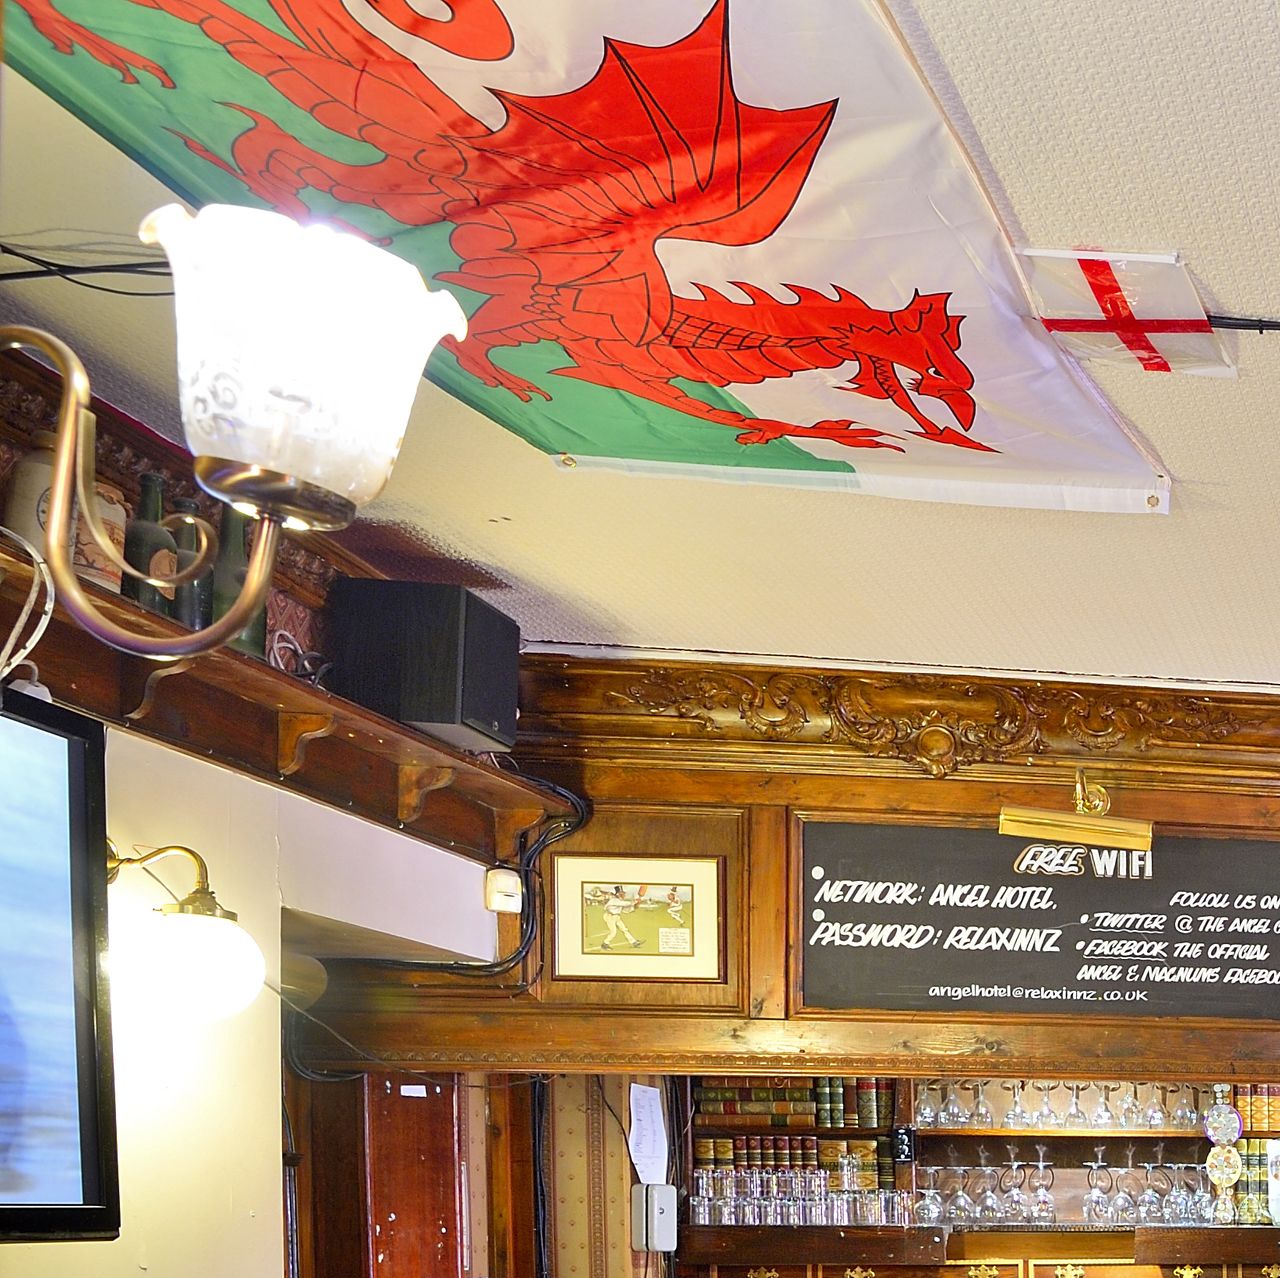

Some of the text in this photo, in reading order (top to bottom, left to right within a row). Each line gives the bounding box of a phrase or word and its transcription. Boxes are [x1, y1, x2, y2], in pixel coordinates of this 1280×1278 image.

[1015, 845, 1153, 879] FREE WIFI
[814, 880, 925, 905] NETWORK:
[929, 883, 990, 908] ANGEL
[1169, 891, 1231, 908] FOLLOW
[1233, 894, 1256, 909] US
[1093, 912, 1167, 930] TWITTER
[1174, 914, 1193, 933] @
[1197, 915, 1227, 933] THE
[1228, 917, 1271, 934] ANGEL
[943, 926, 1062, 952] RELAXINNZ
[1086, 939, 1270, 960] FACEBOOK THE OFFICIAL
[1076, 964, 1122, 981] ANGEL
[1126, 963, 1139, 982] &
[1141, 966, 1220, 983] MAGNUMS
[928, 984, 1148, 1002] angelhotel@relaxinnz.co.uk
